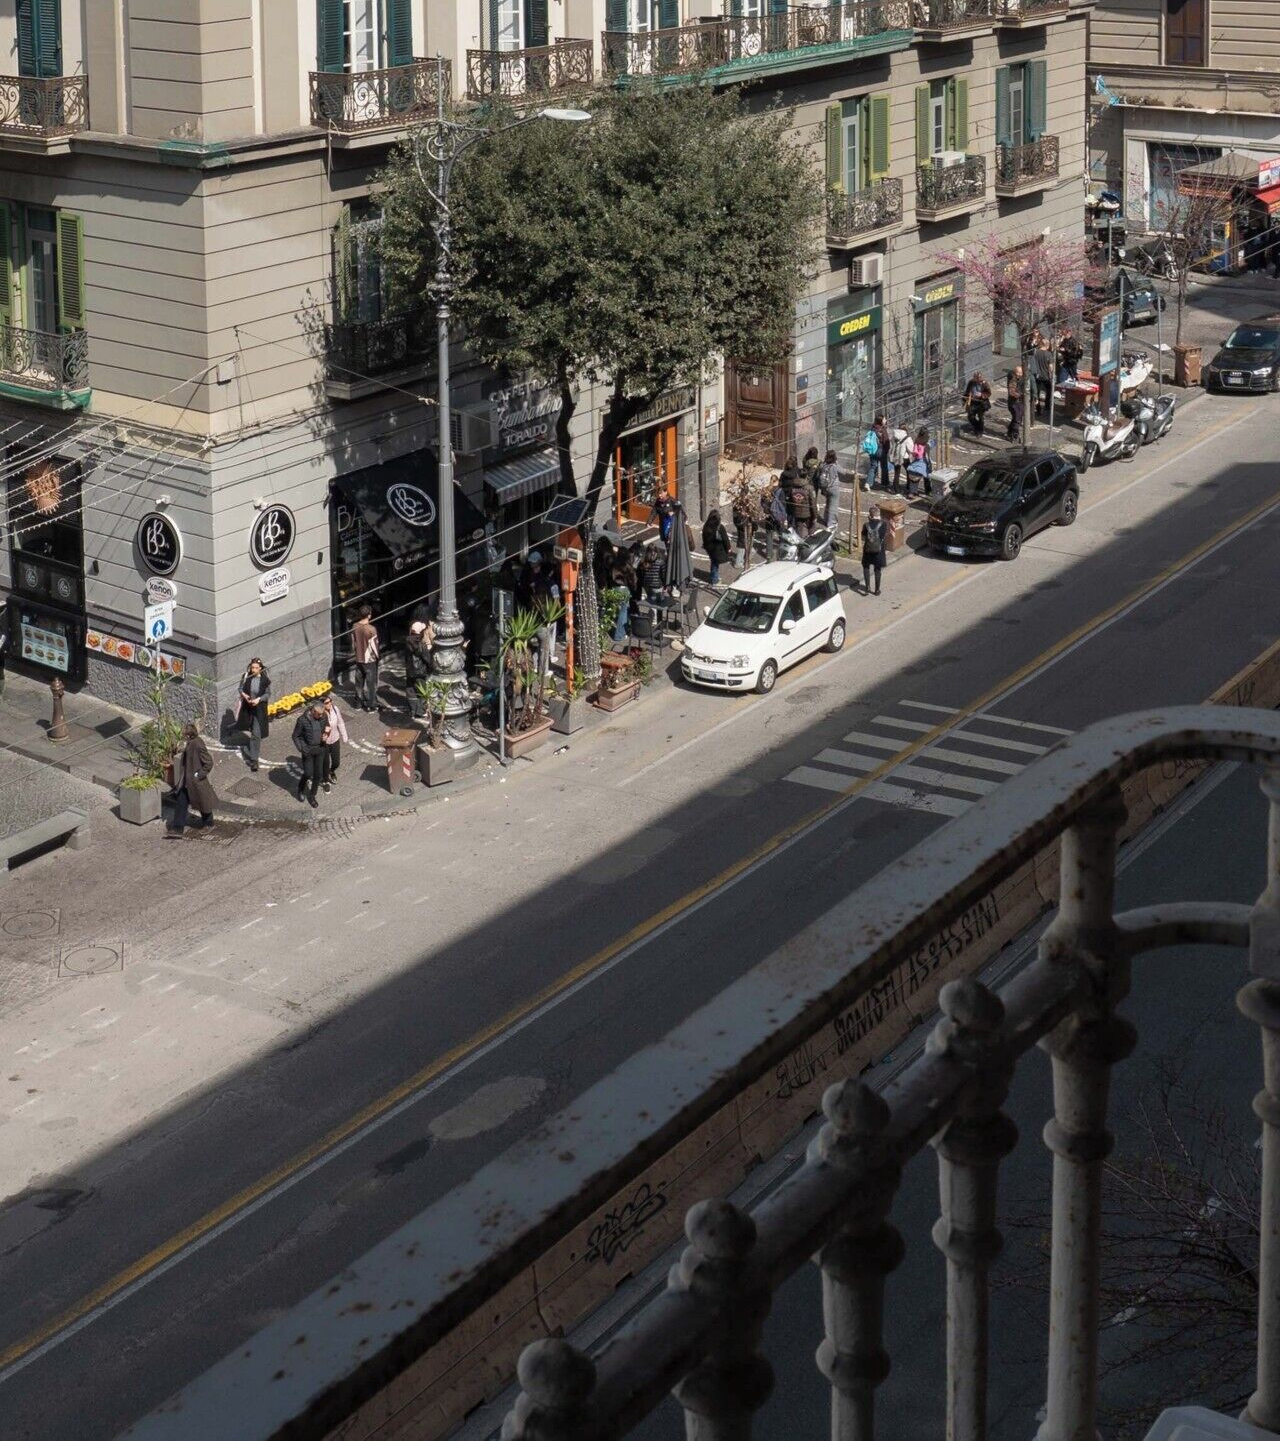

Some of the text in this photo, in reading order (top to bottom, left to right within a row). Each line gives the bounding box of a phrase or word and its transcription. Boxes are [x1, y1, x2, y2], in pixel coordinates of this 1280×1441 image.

[925, 284, 954, 303] CREDEM
[839, 313, 871, 336] CREDEM
[505, 423, 548, 446] TORALDO
